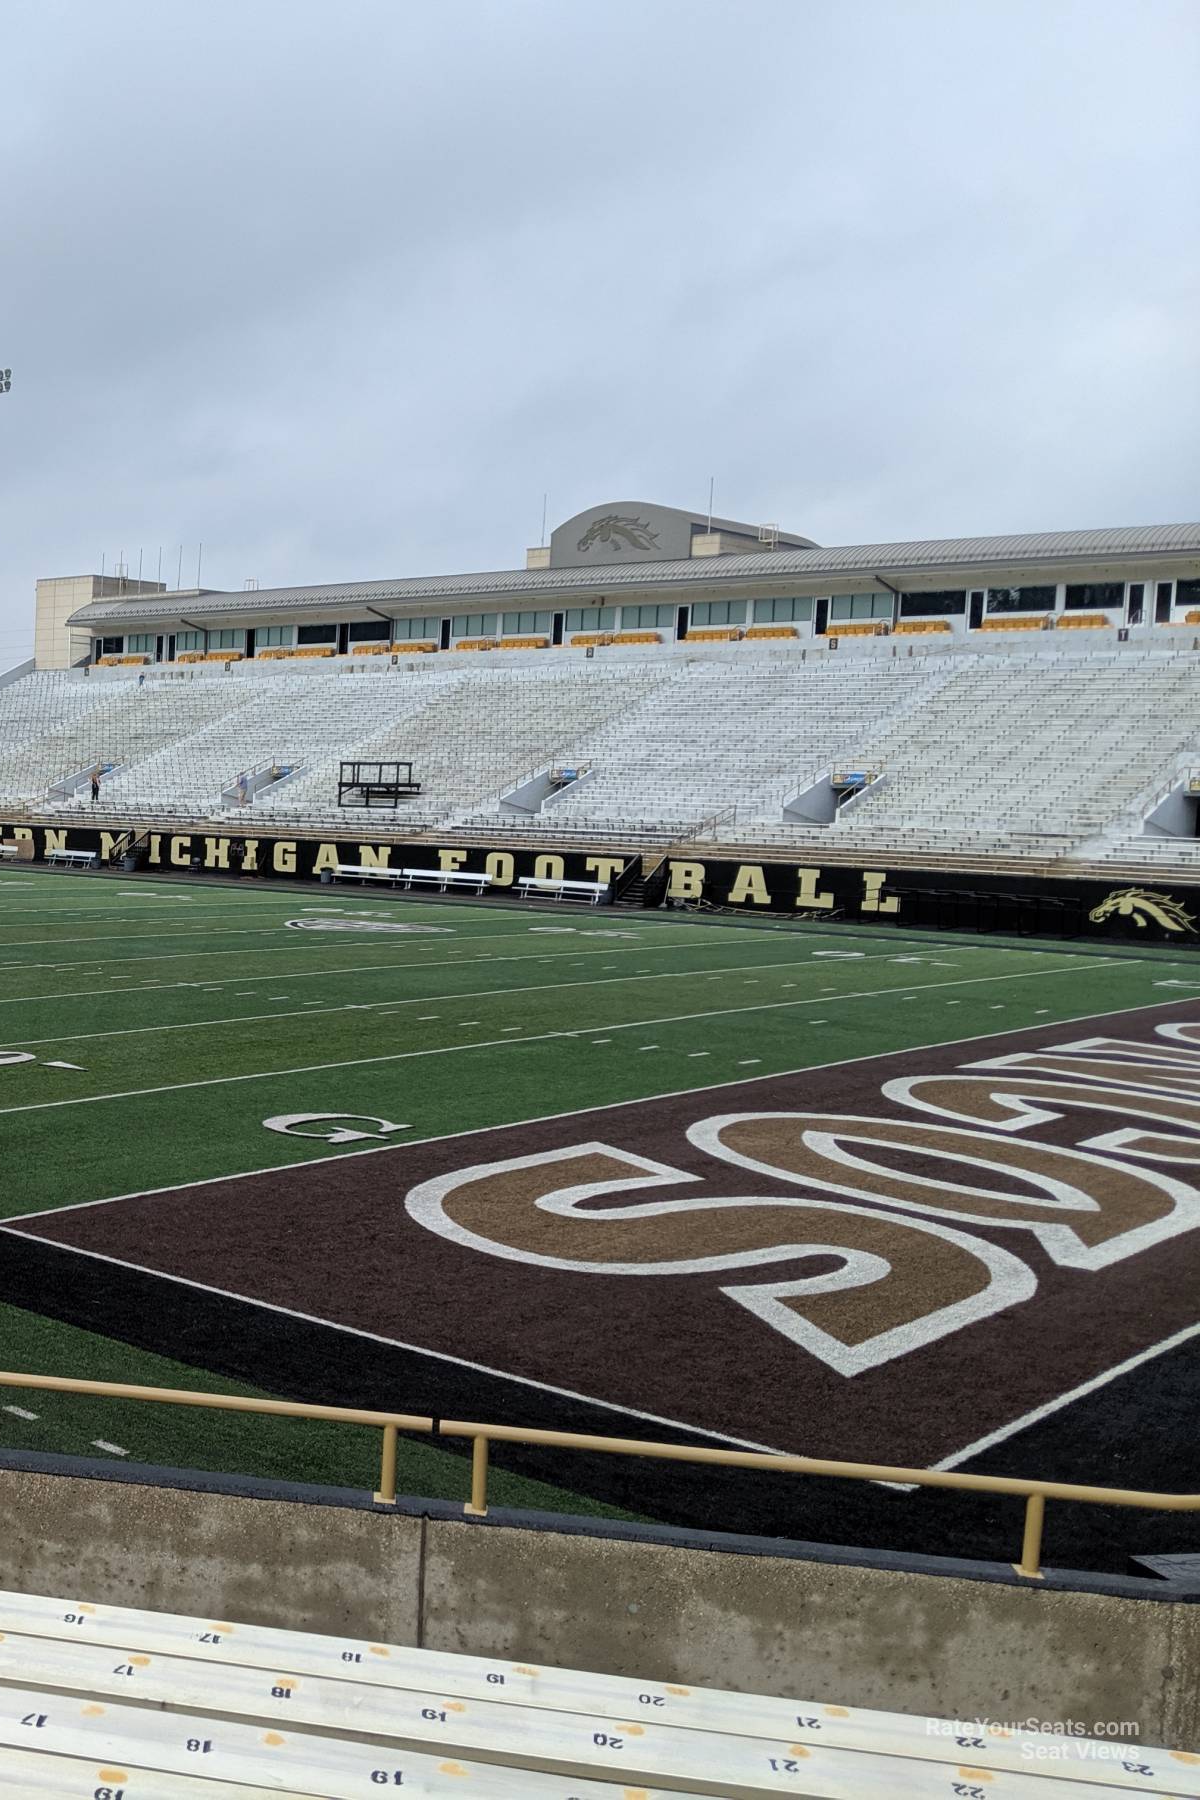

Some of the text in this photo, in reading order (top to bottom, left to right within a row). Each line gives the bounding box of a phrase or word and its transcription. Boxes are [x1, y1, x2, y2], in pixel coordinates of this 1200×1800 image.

[261, 1112, 414, 1145] G
[63, 1613, 85, 1625] 16
[198, 1633, 221, 1645] 17
[341, 1651, 362, 1664] 18
[112, 1664, 134, 1677] 17
[486, 1673, 505, 1685] 19
[270, 1686, 292, 1699] 18
[638, 1694, 665, 1707] 20
[20, 1712, 48, 1728] 17
[421, 1708, 447, 1723] 19
[796, 1716, 822, 1730] 21
[186, 1738, 212, 1754] 18
[593, 1733, 624, 1750] 20
[954, 1736, 987, 1749] 22
[768, 1758, 800, 1773] 21
[1121, 1761, 1155, 1777] 23
[370, 1770, 404, 1786] 19
[951, 1782, 986, 1800] 22
